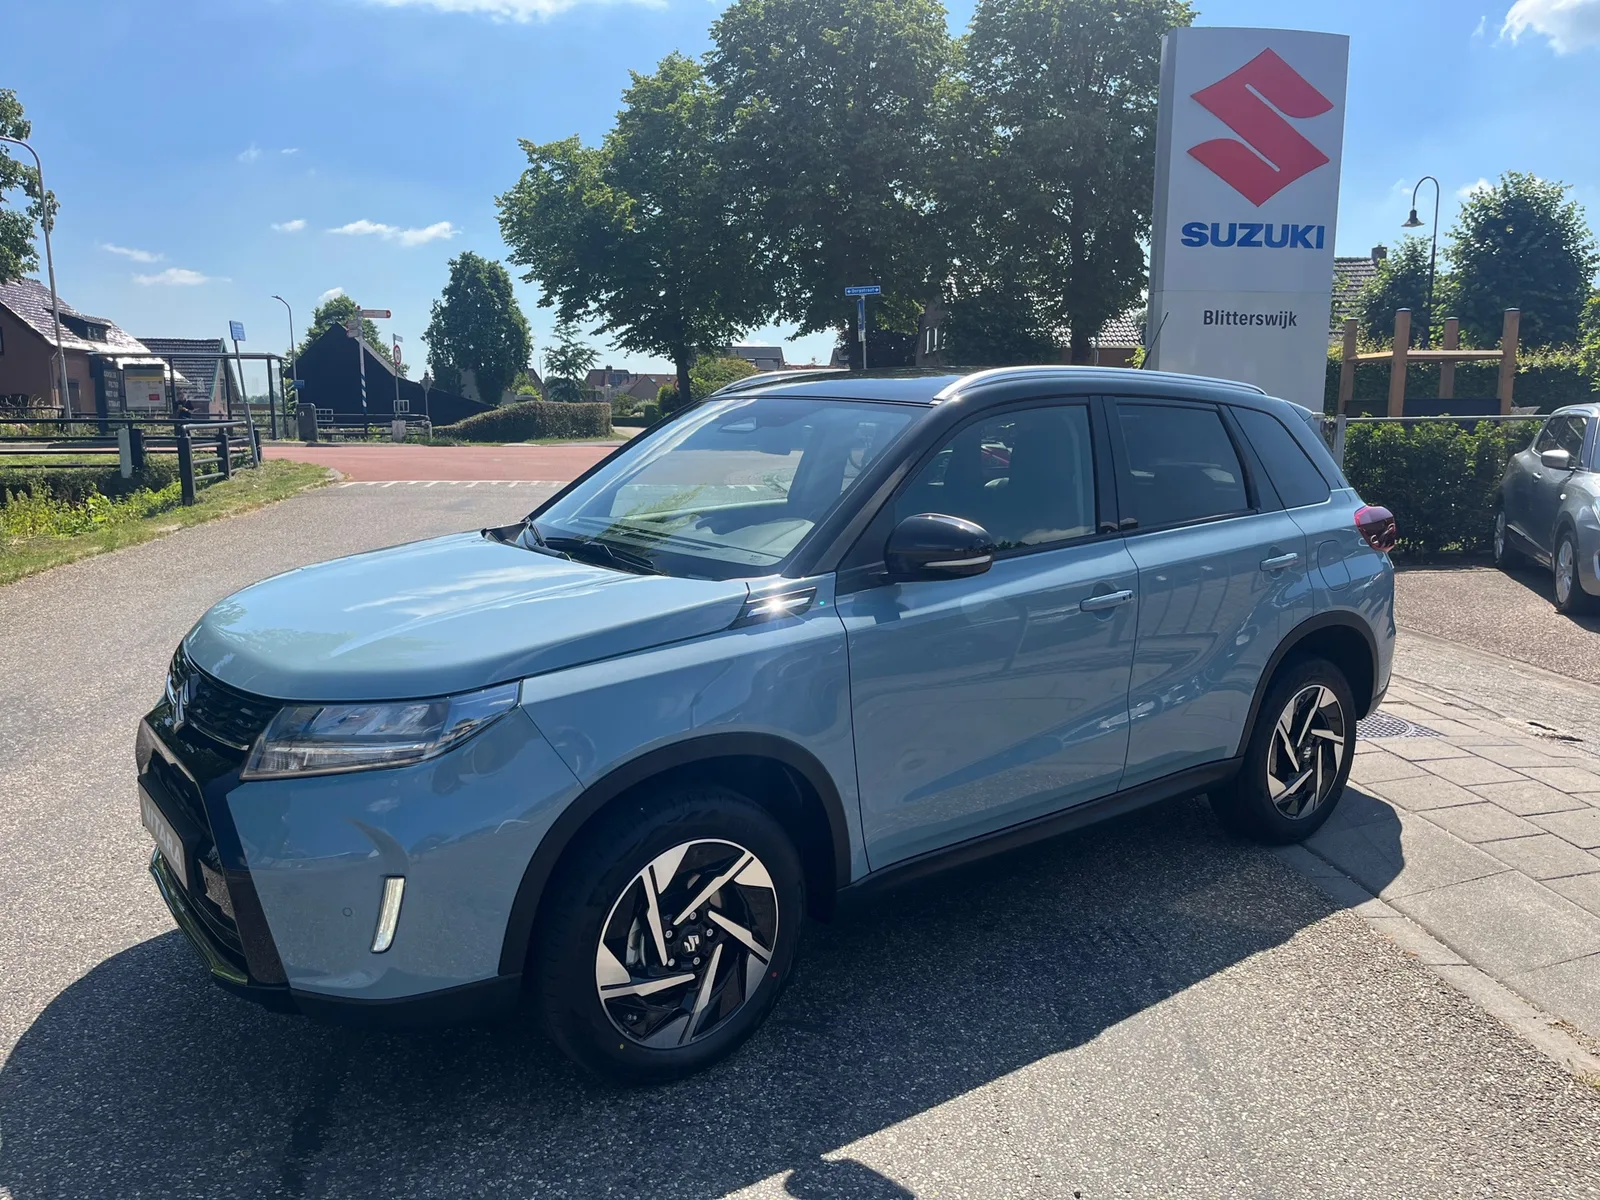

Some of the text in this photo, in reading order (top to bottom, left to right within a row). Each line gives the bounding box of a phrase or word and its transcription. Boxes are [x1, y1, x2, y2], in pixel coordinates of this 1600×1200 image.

[1181, 222, 1325, 249] SUZUKI
[1203, 310, 1298, 329] Blitterswijk
[142, 796, 182, 871] VITARA
